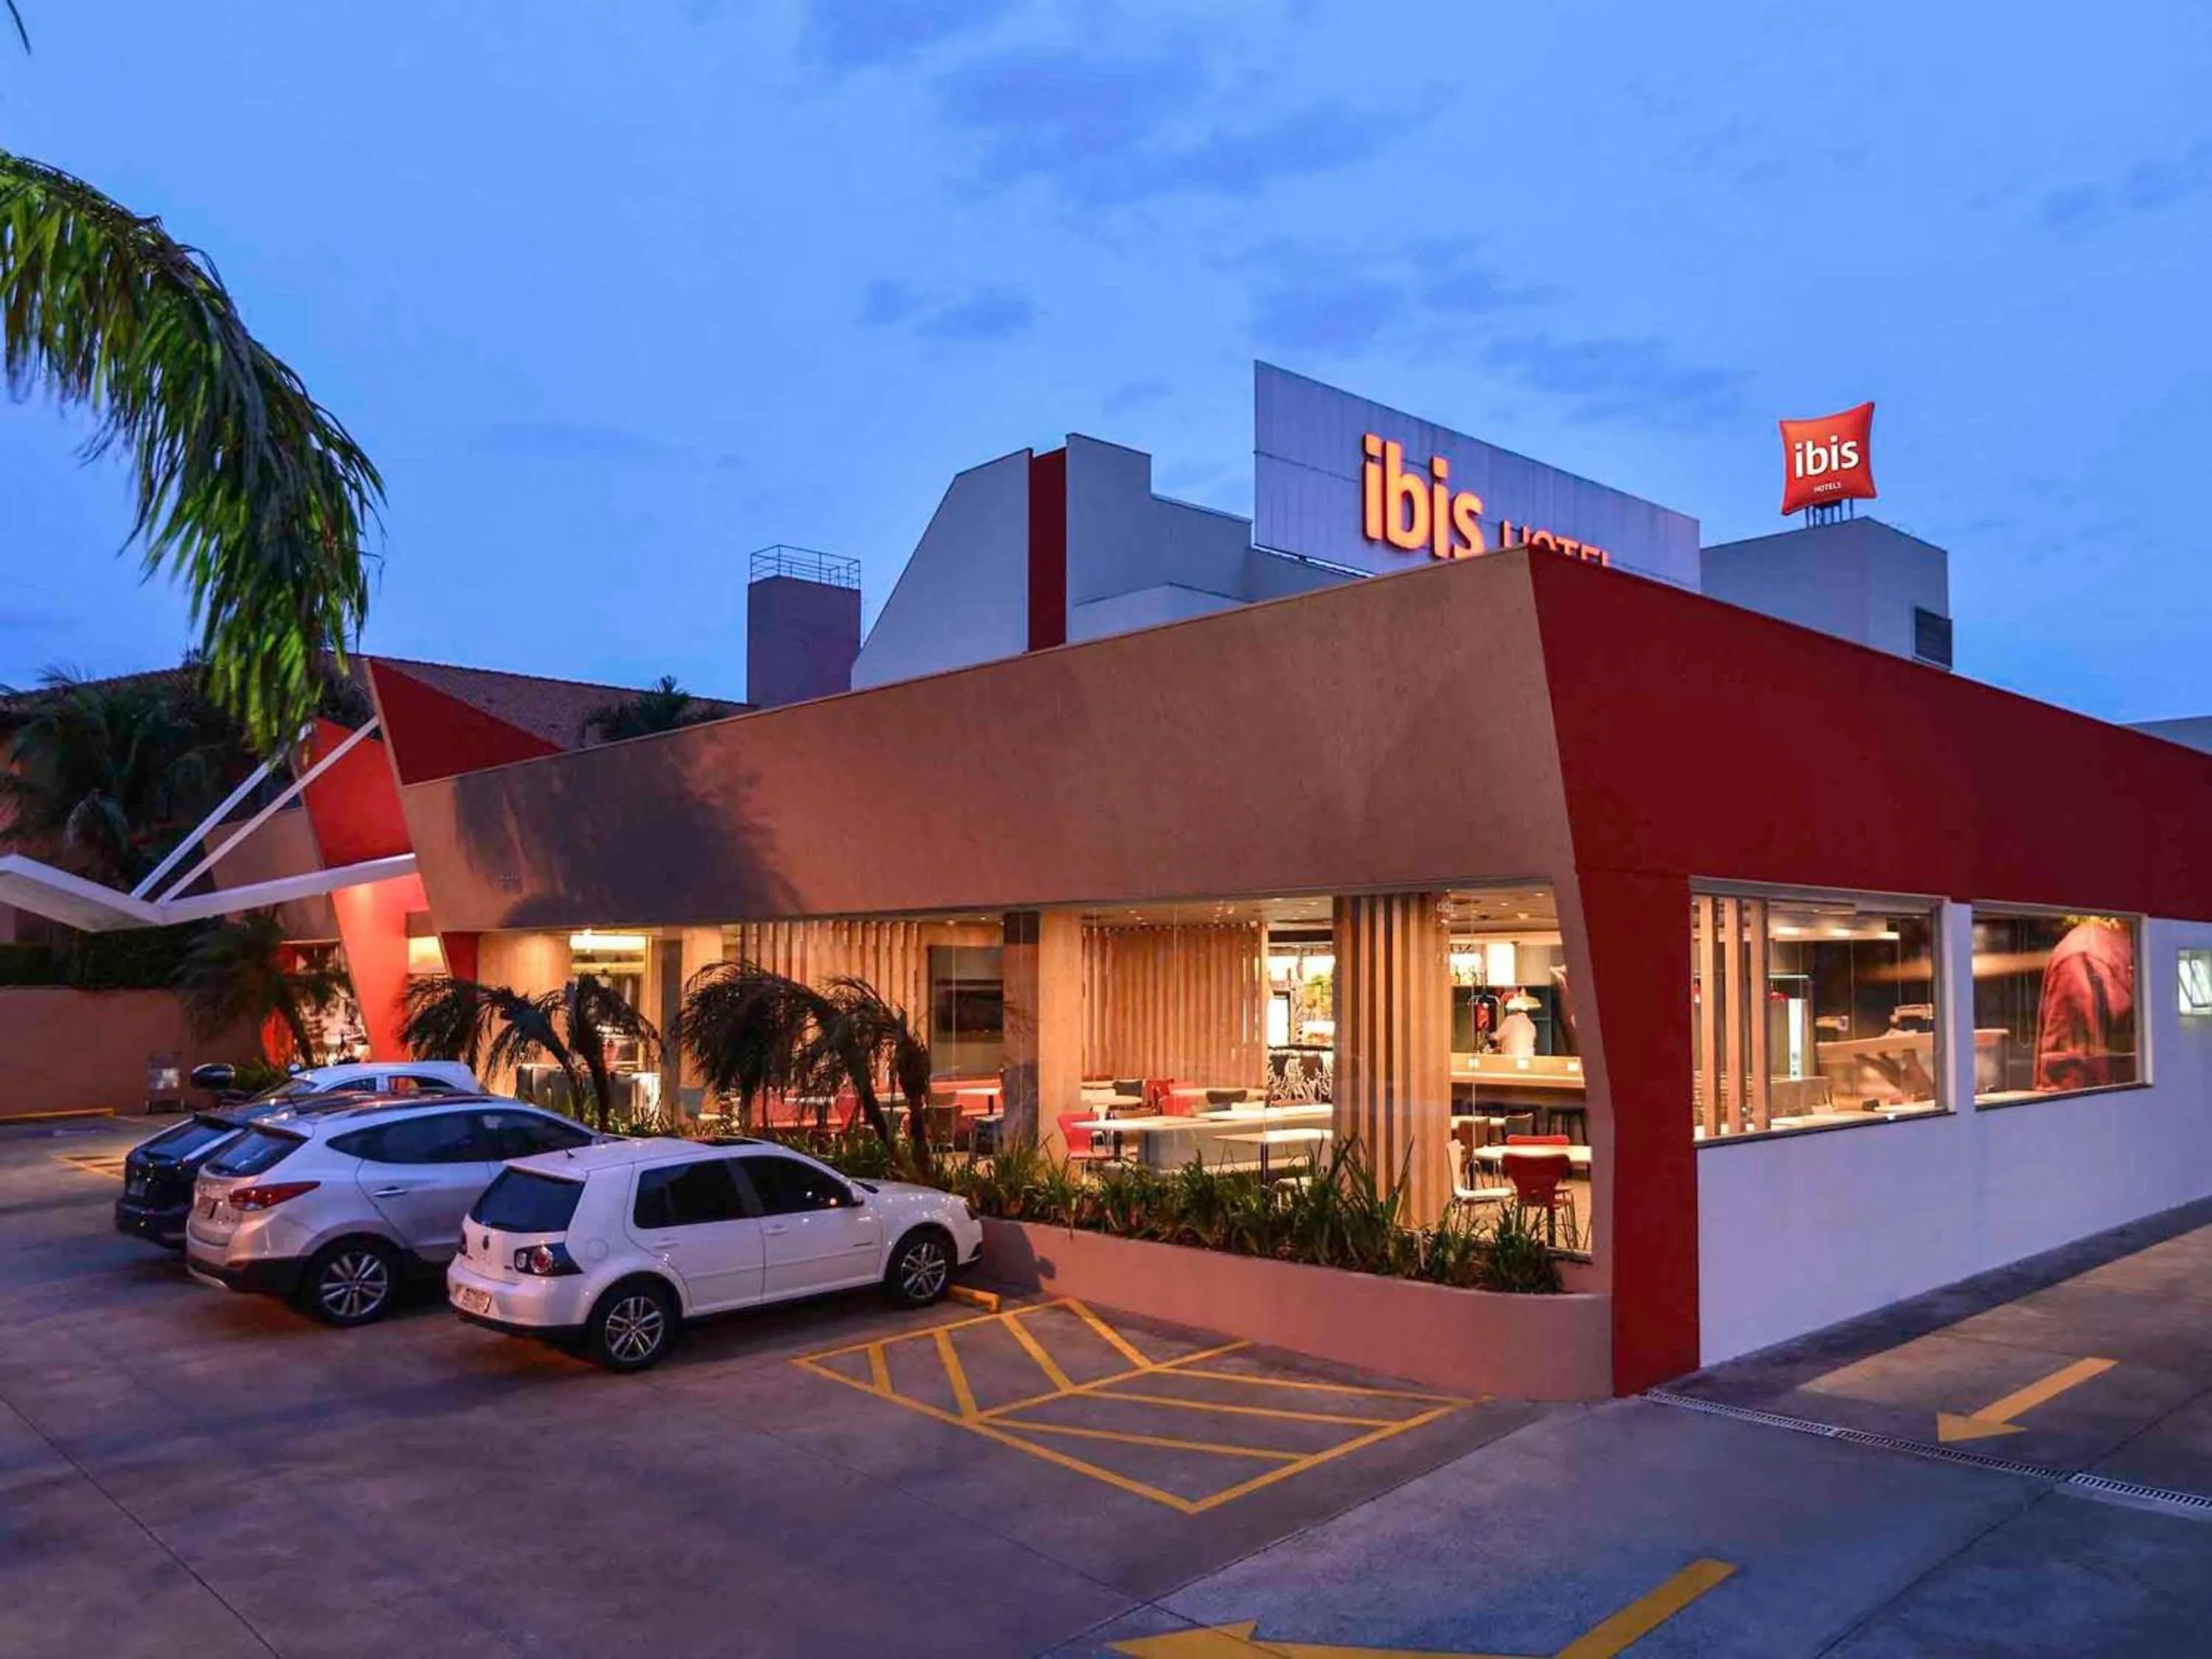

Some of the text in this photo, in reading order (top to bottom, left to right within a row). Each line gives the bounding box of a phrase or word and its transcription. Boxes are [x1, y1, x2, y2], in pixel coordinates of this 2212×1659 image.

[1795, 434, 1860, 479] ibis
[1363, 432, 1486, 559] ibis
[1813, 481, 1841, 493] HOTELS
